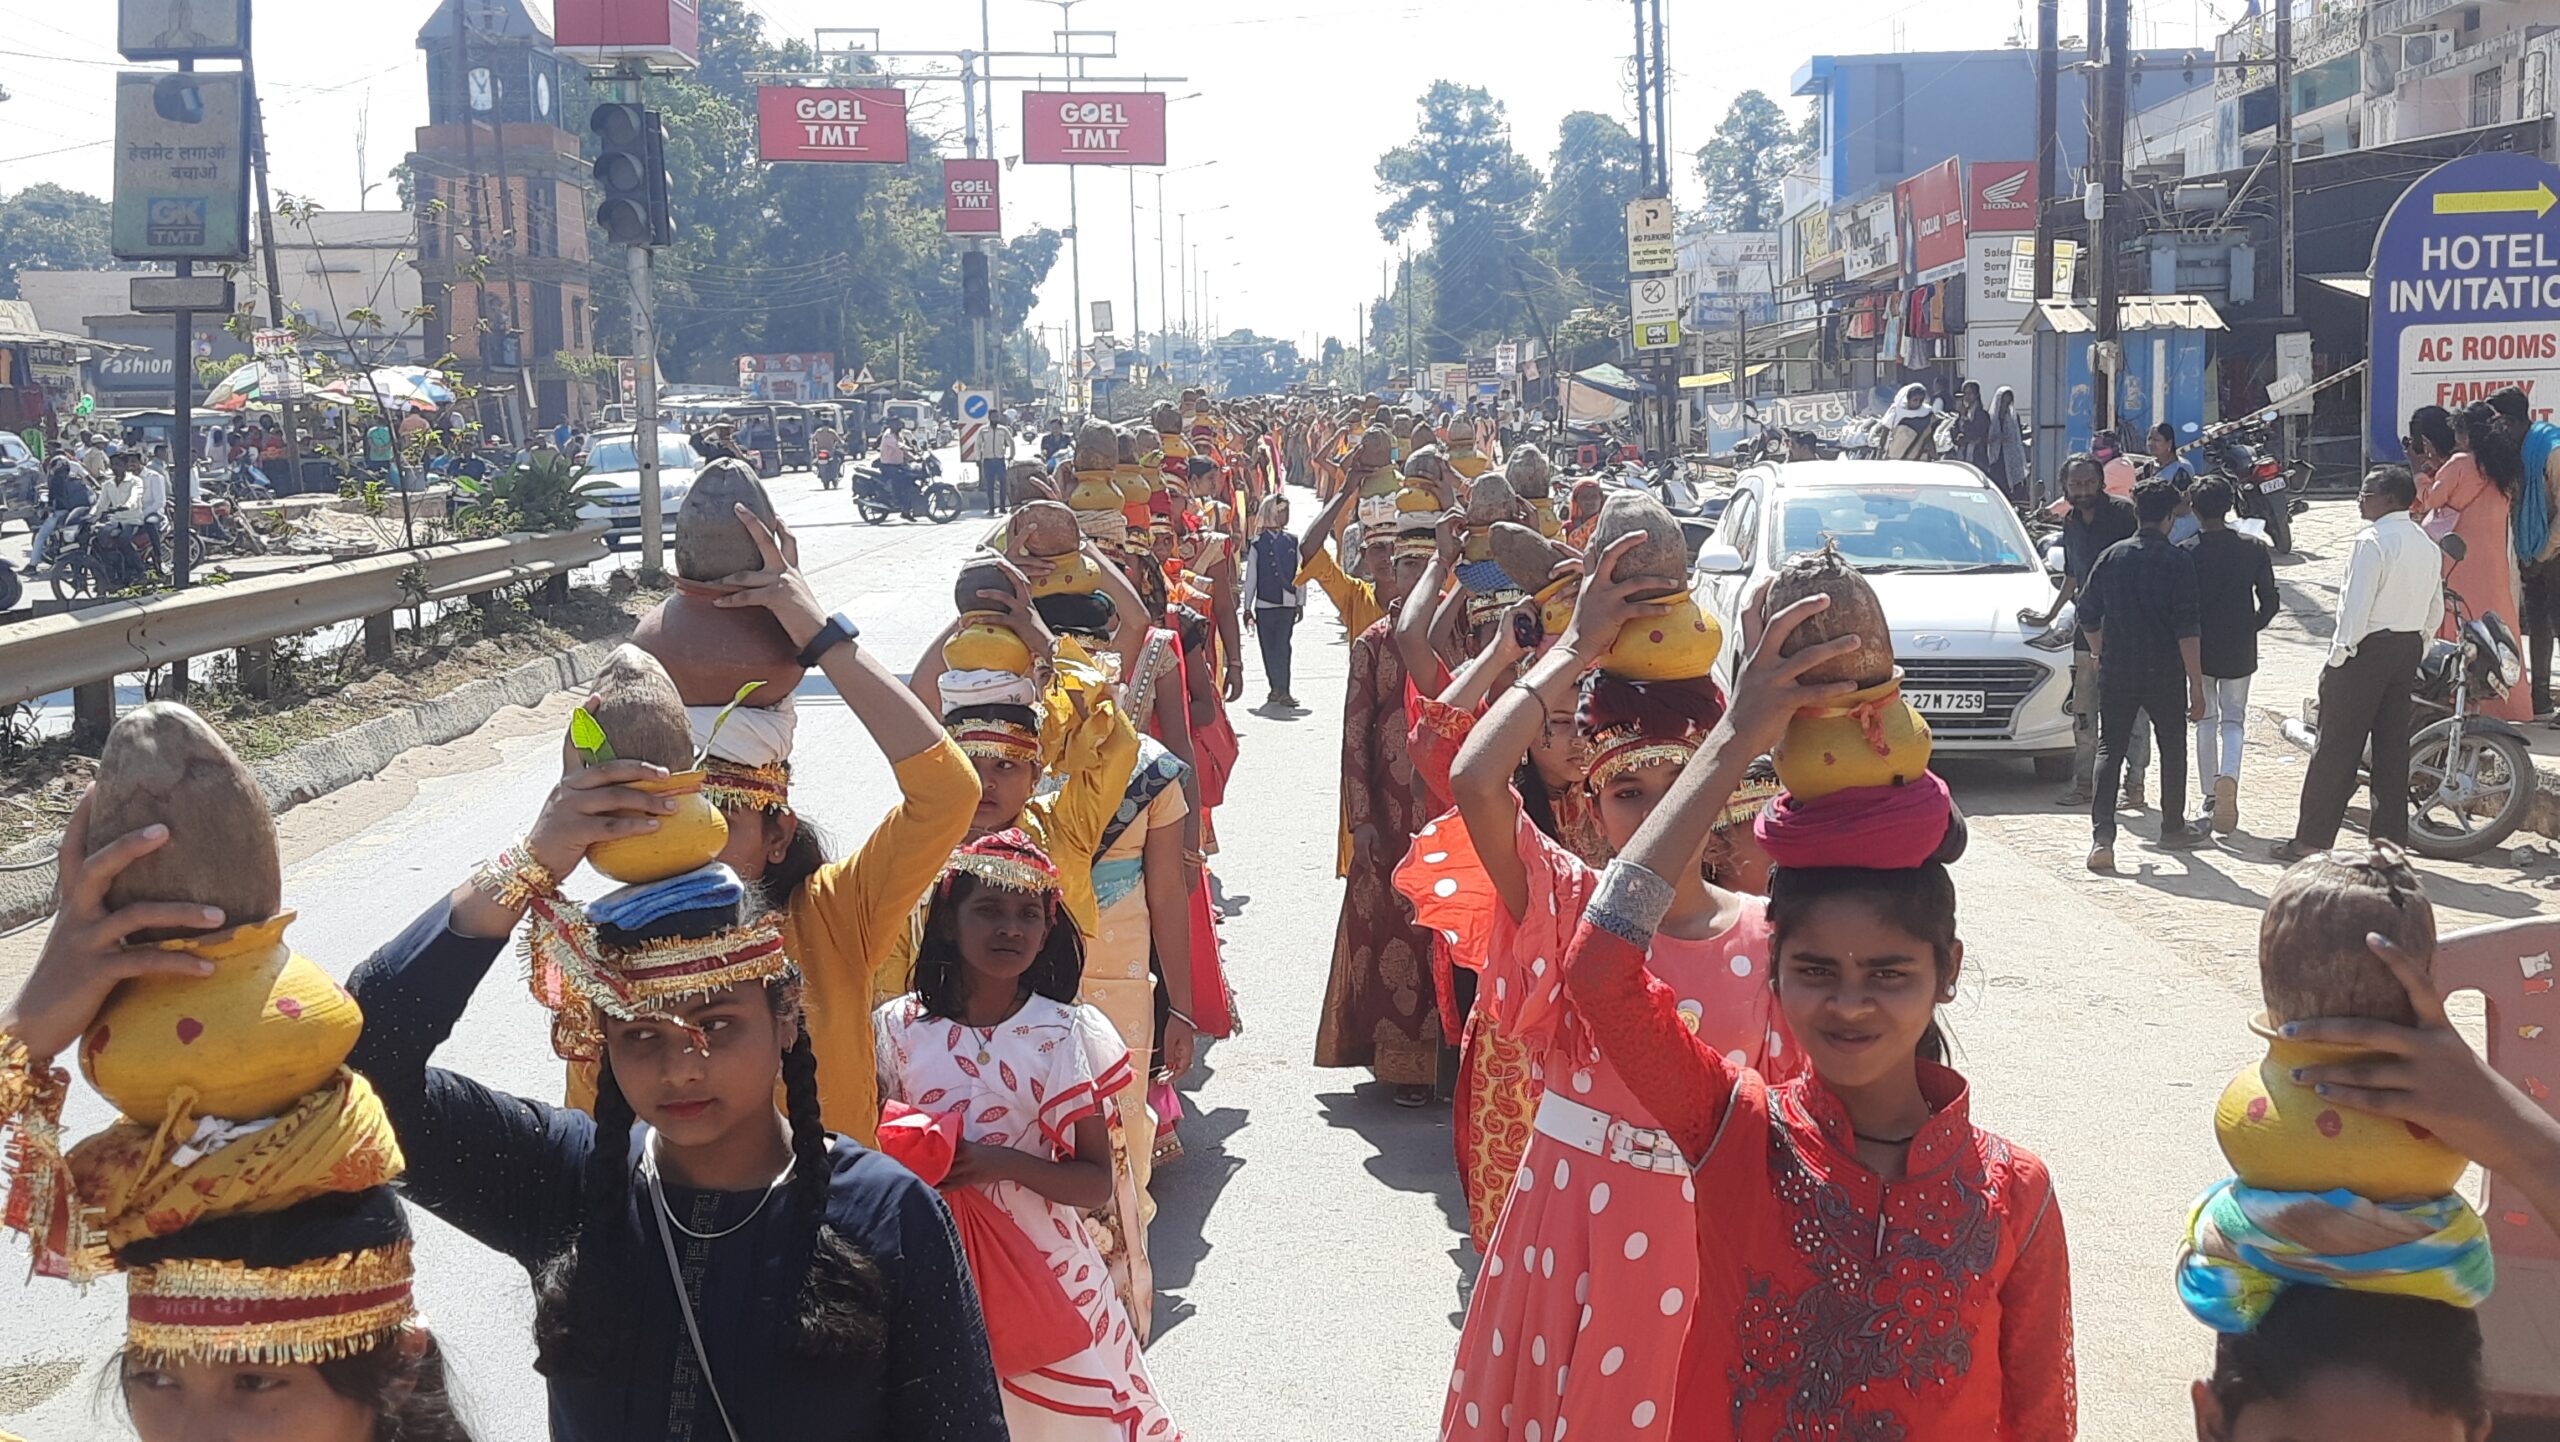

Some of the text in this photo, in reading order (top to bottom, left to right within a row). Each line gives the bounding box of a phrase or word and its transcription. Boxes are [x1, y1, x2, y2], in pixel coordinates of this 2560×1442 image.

[796, 99, 867, 120] GOEL
[1060, 102, 1128, 123] GOEL
[804, 125, 859, 145] TMT
[1068, 128, 1121, 148] TMT
[128, 142, 174, 162] हेलमेट
[170, 161, 218, 179] बचाओ
[951, 180, 993, 192] GOEL
[956, 195, 989, 207] TMT
[1982, 202, 2029, 210] HONDA
[151, 200, 203, 225] GK
[153, 231, 200, 243] TMT
[1984, 248, 2012, 257] Sales
[2422, 233, 2558, 271] HOTEL
[1984, 276, 2008, 286] Spar
[1984, 289, 2007, 299] Safe
[1978, 351, 2006, 359] Honda
[2418, 334, 2557, 362] AC ROOMS
[100, 357, 173, 374] Fashion
[1913, 694, 1931, 709] 27
[1946, 694, 1983, 709] 7259
